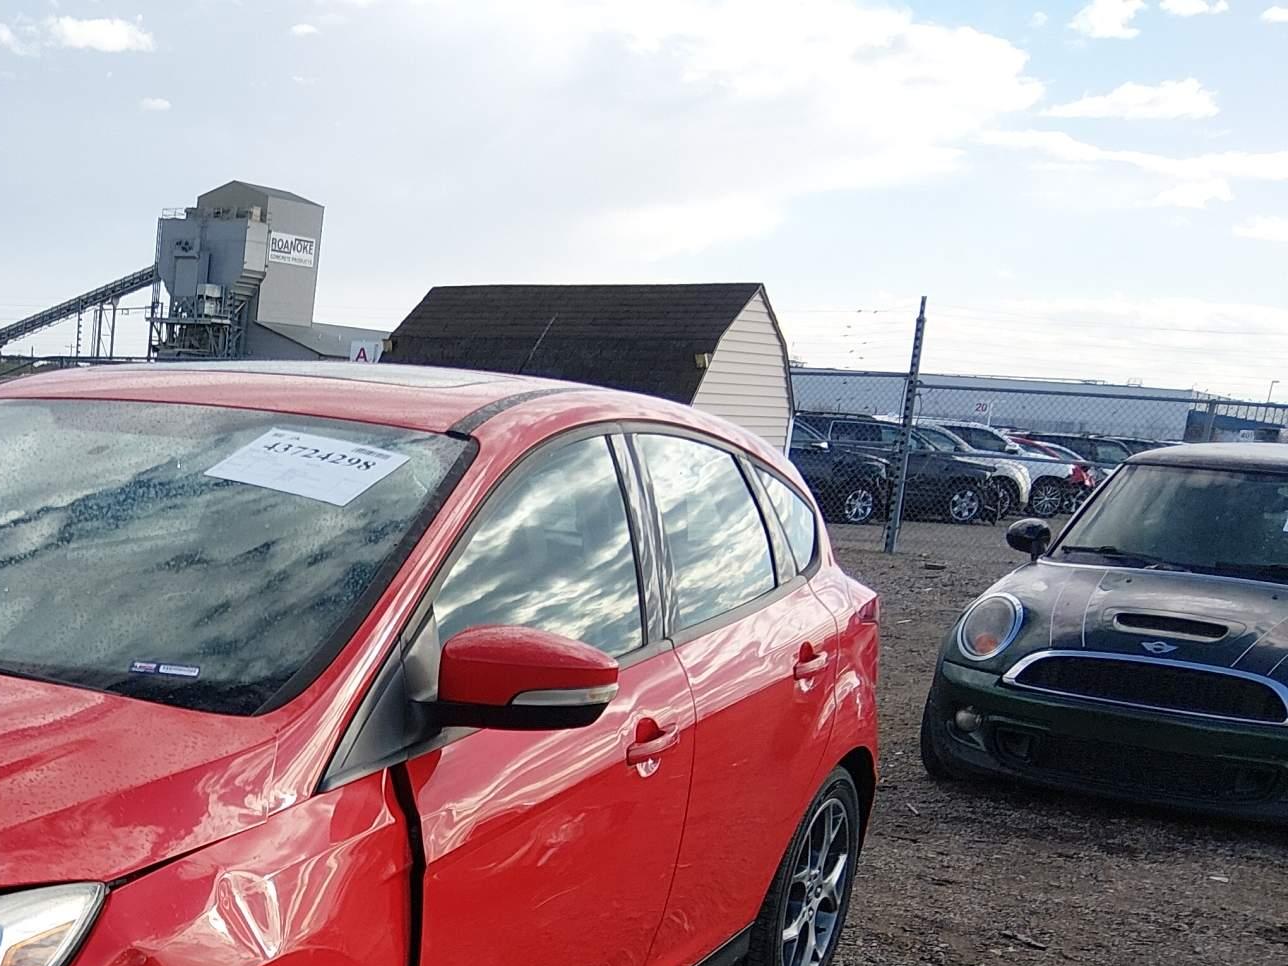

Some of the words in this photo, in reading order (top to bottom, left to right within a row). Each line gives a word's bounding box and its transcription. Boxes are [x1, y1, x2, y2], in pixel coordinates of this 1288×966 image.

[271, 237, 314, 255] ROANOKE
[355, 347, 368, 362] A
[975, 402, 988, 412] 20
[263, 442, 376, 471] 43724298
